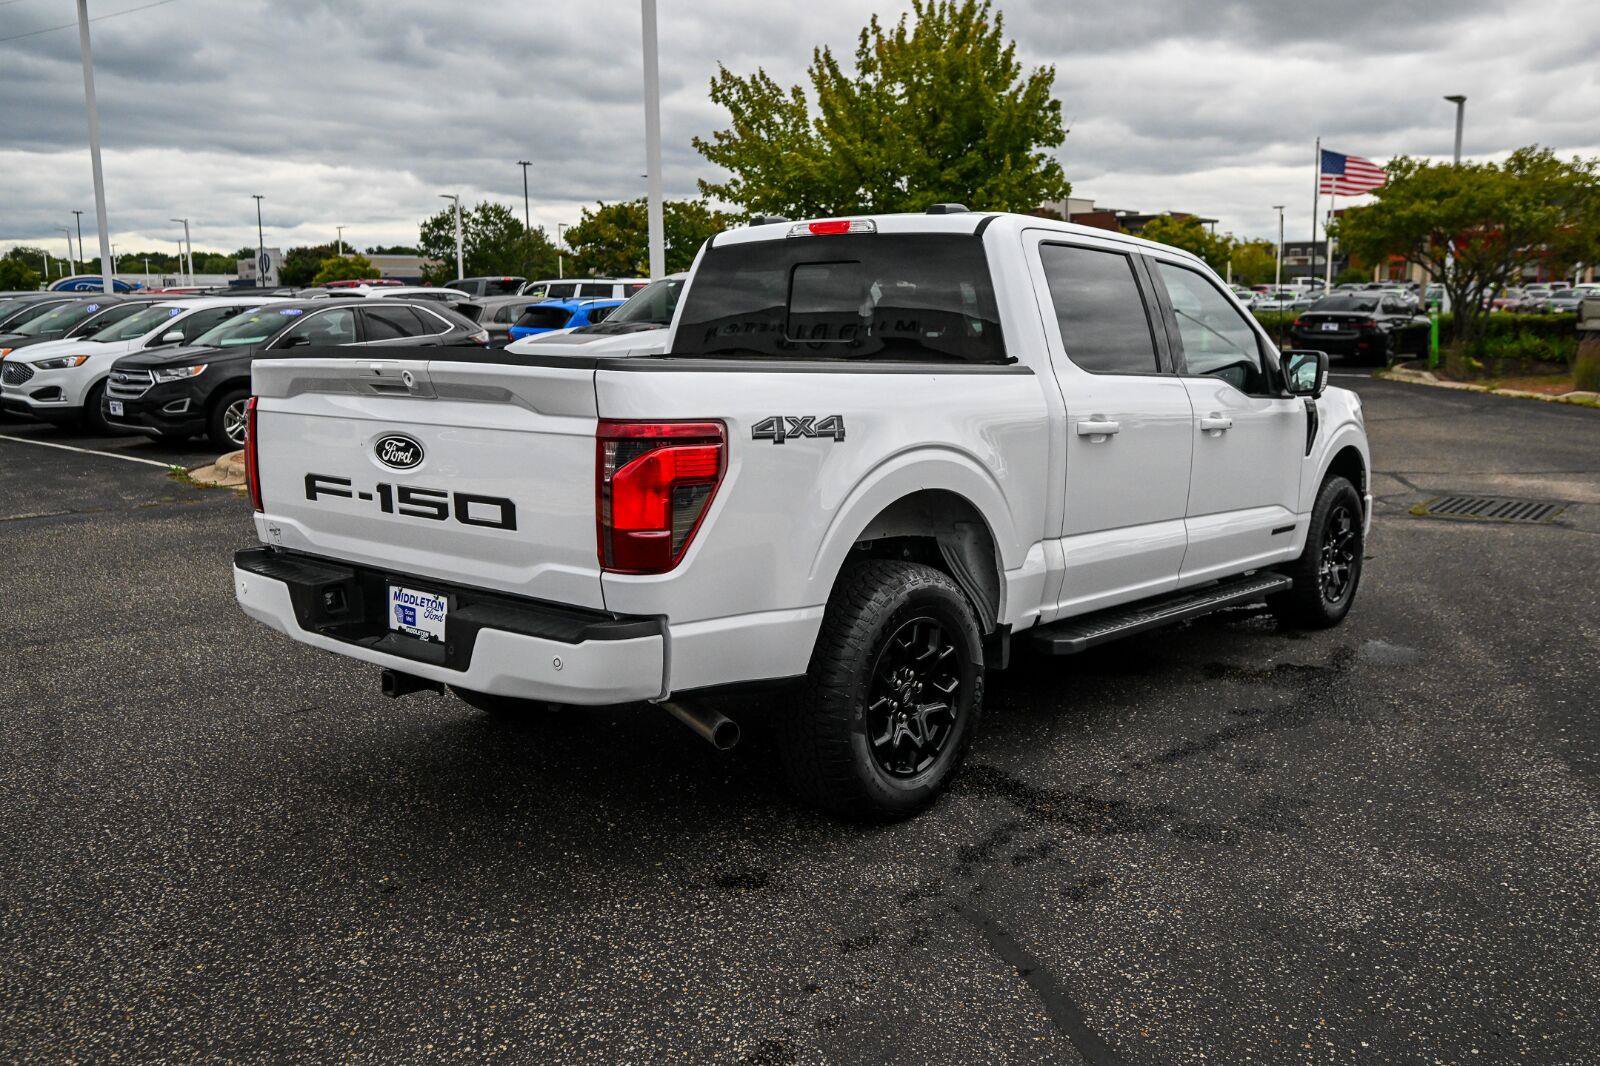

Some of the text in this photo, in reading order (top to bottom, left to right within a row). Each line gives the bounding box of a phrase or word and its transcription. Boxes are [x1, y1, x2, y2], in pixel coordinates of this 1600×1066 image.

[382, 440, 413, 463] Ford
[304, 472, 518, 532] F-150
[393, 590, 445, 612] MIDDLETON
[423, 605, 445, 622] Ford
